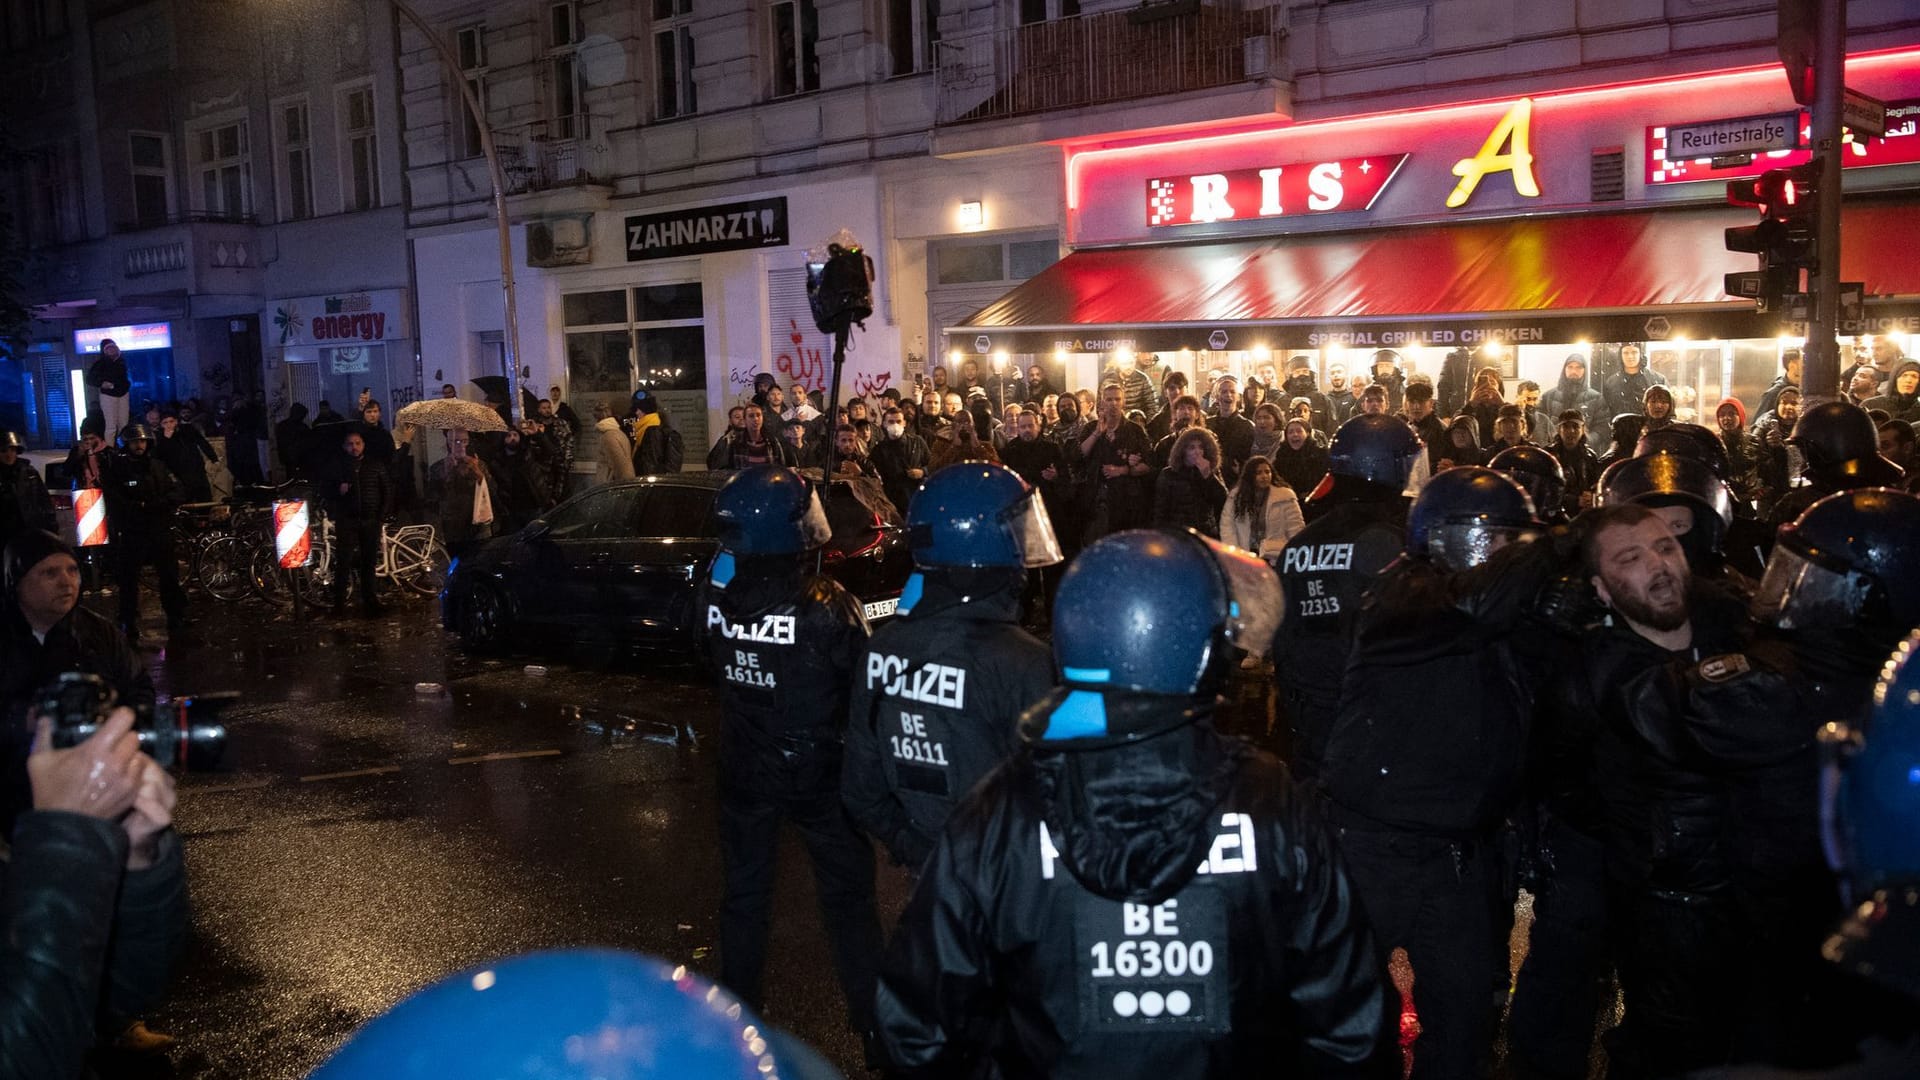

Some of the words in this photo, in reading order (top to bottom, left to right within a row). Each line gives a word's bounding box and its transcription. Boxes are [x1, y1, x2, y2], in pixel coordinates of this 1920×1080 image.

[1681, 121, 1786, 148] Reuterstraße
[1446, 97, 1540, 208] A
[629, 210, 757, 251] ZAHNARZT
[311, 312, 386, 341] energy
[1308, 332, 1377, 346] SPECIAL
[1381, 330, 1456, 344] GRILLED
[1460, 328, 1543, 343] CHICKEN
[1843, 316, 1920, 331] CHICKE
[1085, 339, 1137, 350] CHICKEN
[1283, 543, 1355, 574] POLIZEI
[1307, 579, 1325, 597] BE
[1300, 596, 1341, 617] 22313
[735, 649, 760, 668] BE
[724, 664, 777, 689] 16114
[867, 651, 966, 710] POLIZEI
[900, 711, 928, 738] BE
[890, 735, 949, 766] 16111
[1123, 898, 1179, 936] BE
[1090, 940, 1214, 978] 16300
